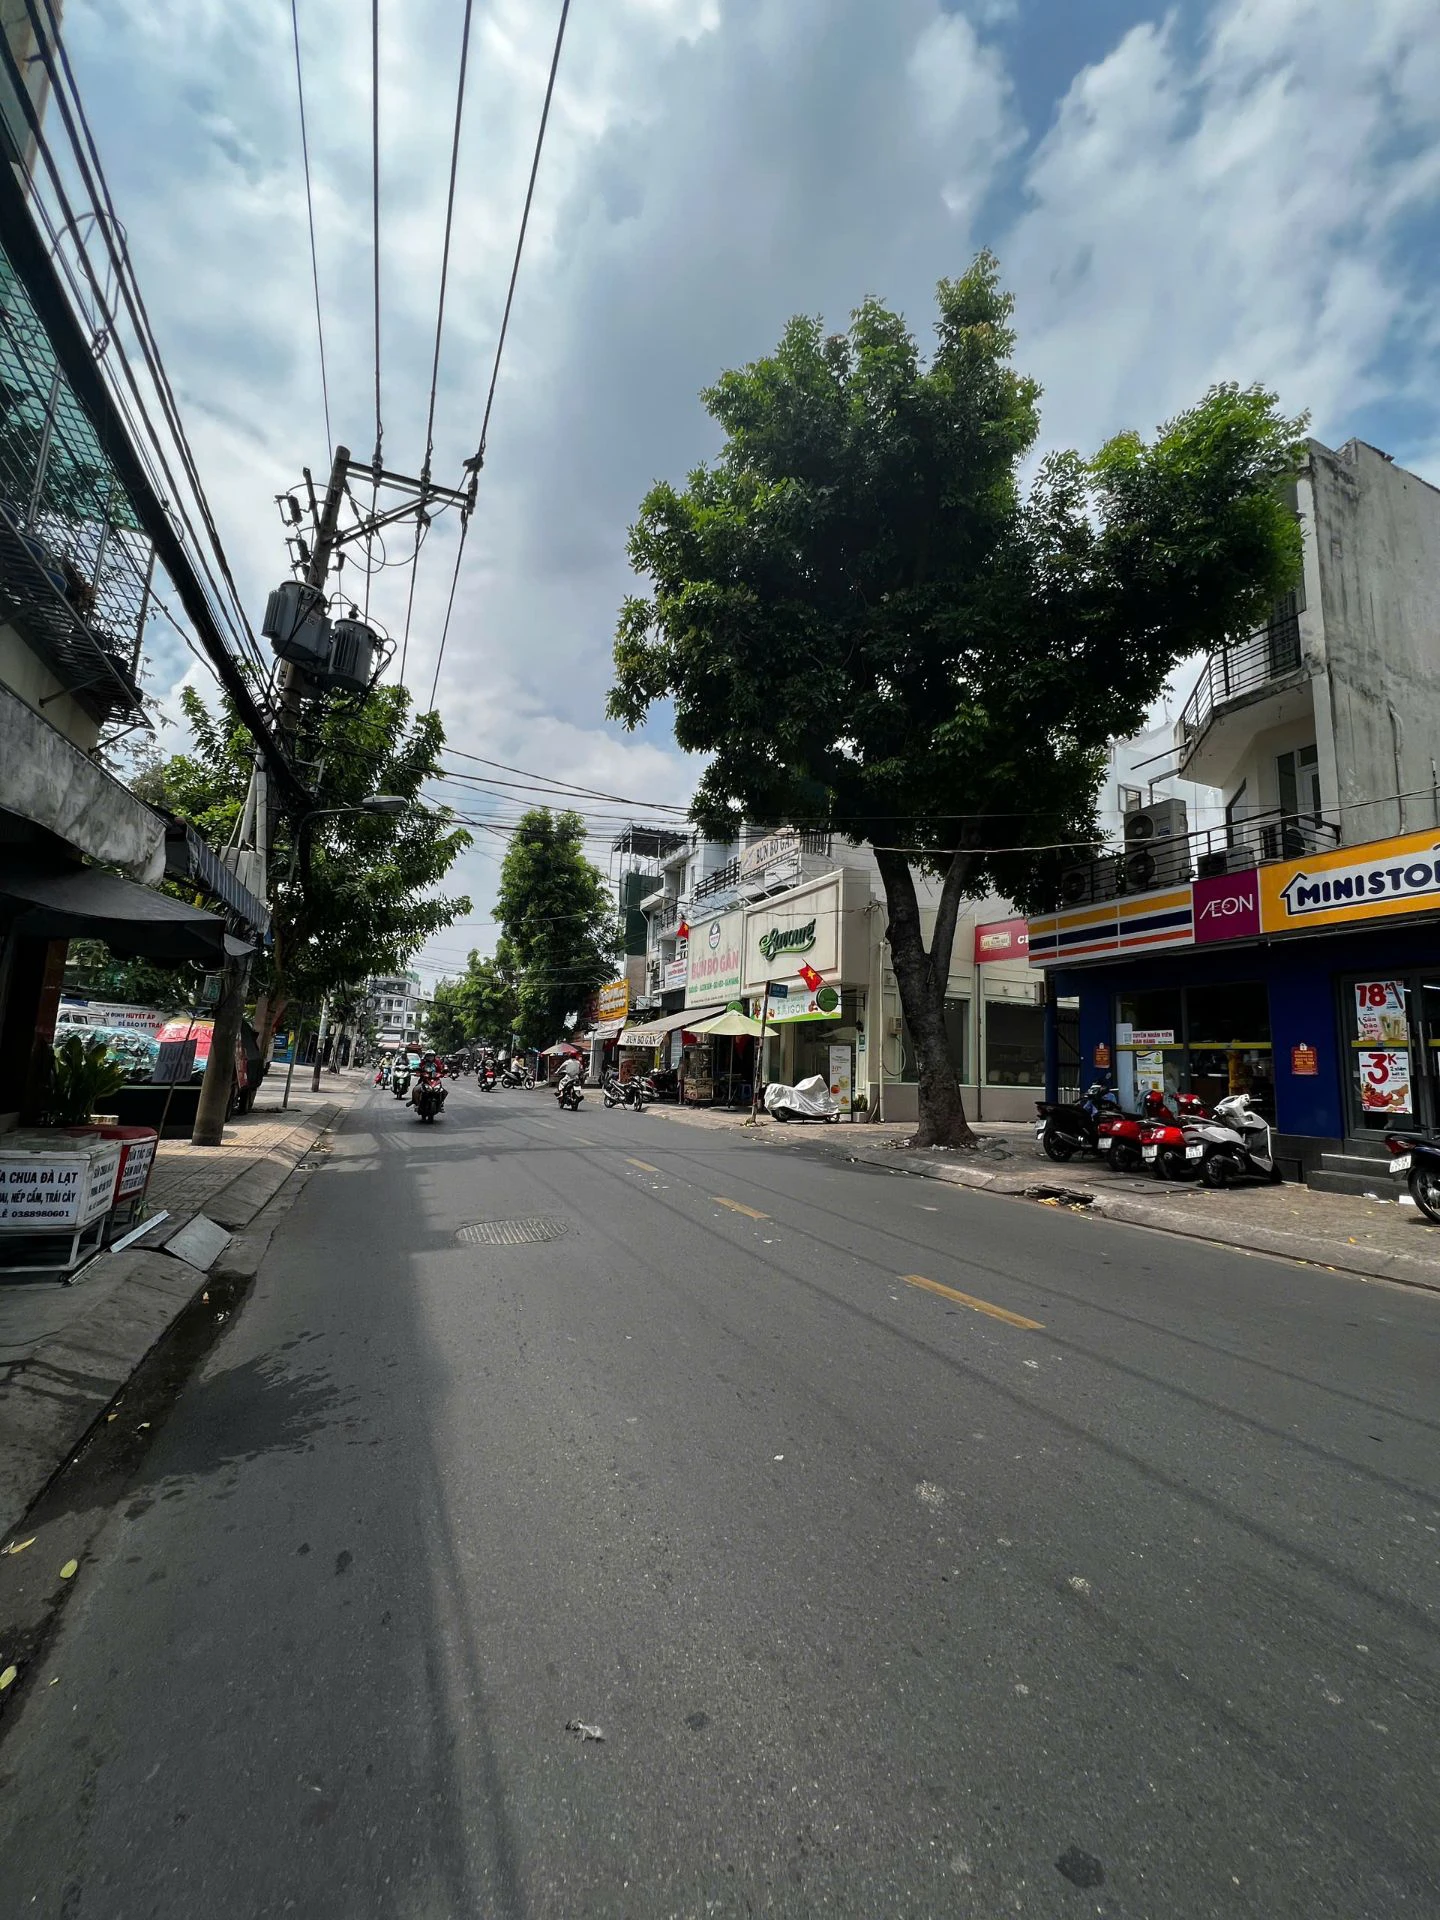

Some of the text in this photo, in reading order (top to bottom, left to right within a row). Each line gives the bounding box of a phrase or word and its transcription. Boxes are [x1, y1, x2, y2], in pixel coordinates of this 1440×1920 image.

[1297, 860, 1440, 907] MINISTO
[9, 1172, 37, 1184] CHUA
[40, 1168, 54, 1184] ĐÀ
[57, 1172, 78, 1186] LẠT
[45, 1189, 61, 1203] TRÁI
